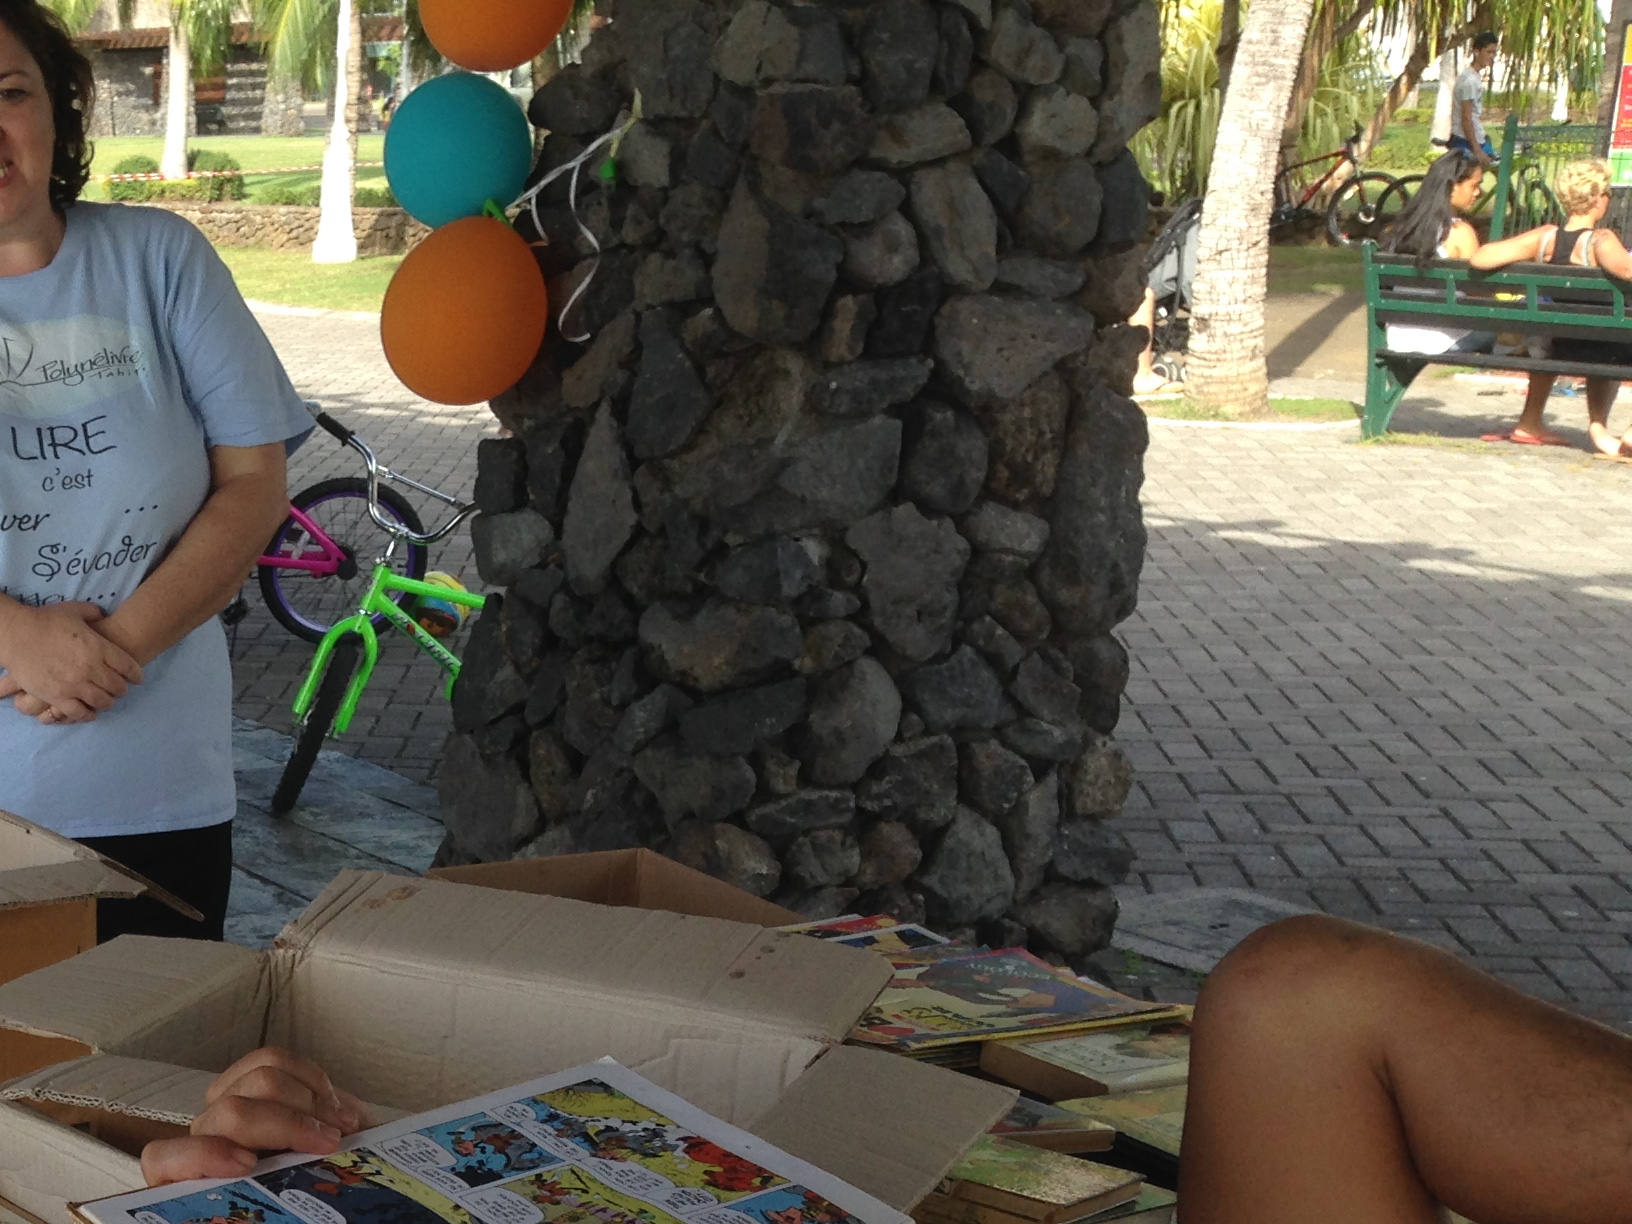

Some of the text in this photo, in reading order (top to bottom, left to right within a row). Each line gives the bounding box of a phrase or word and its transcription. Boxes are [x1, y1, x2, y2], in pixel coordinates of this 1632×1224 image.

[11, 415, 118, 461] LIRE
[42, 468, 94, 492] c'est
[32, 536, 158, 582] S'évader
